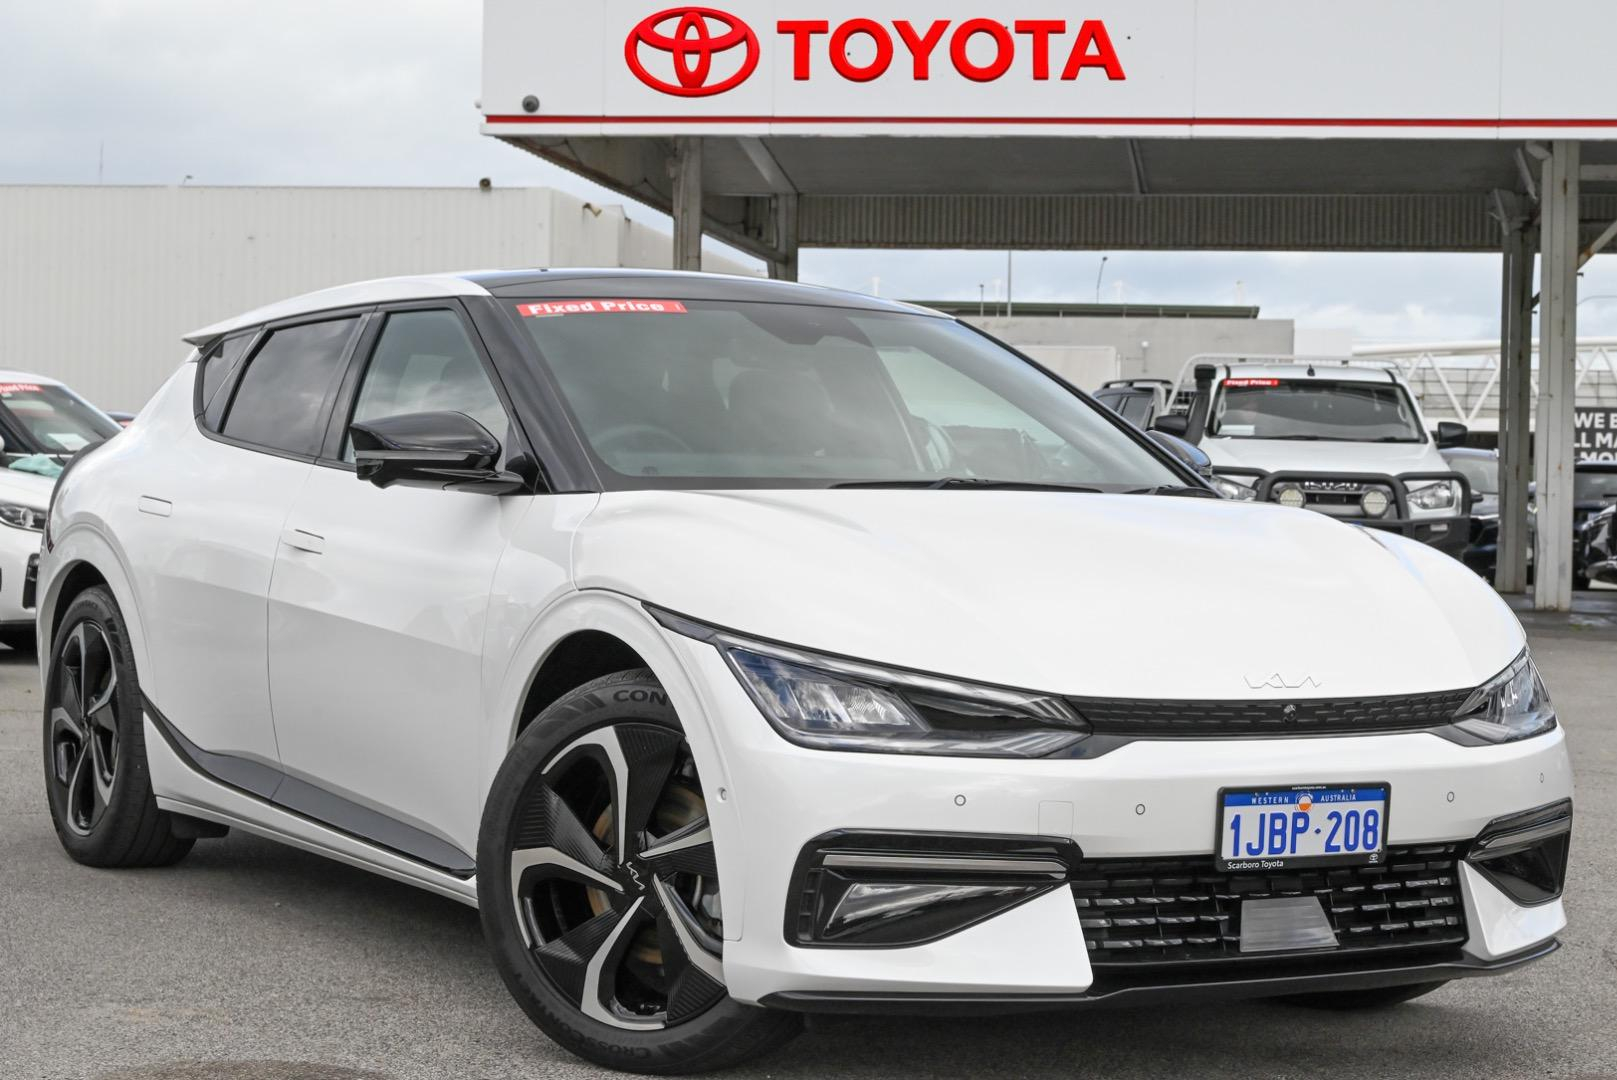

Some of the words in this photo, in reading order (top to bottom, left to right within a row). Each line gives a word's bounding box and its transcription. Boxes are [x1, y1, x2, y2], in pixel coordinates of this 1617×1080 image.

[777, 18, 1126, 82] TOYOTA
[527, 303, 595, 315] Fixed
[600, 301, 664, 312] Price
[1574, 412, 1605, 429] WE
[1251, 796, 1289, 805] WESTERN
[1320, 793, 1356, 803] AUSTRALIA
[1227, 861, 1260, 869] Scarboro
[1261, 860, 1284, 869] Toyota
